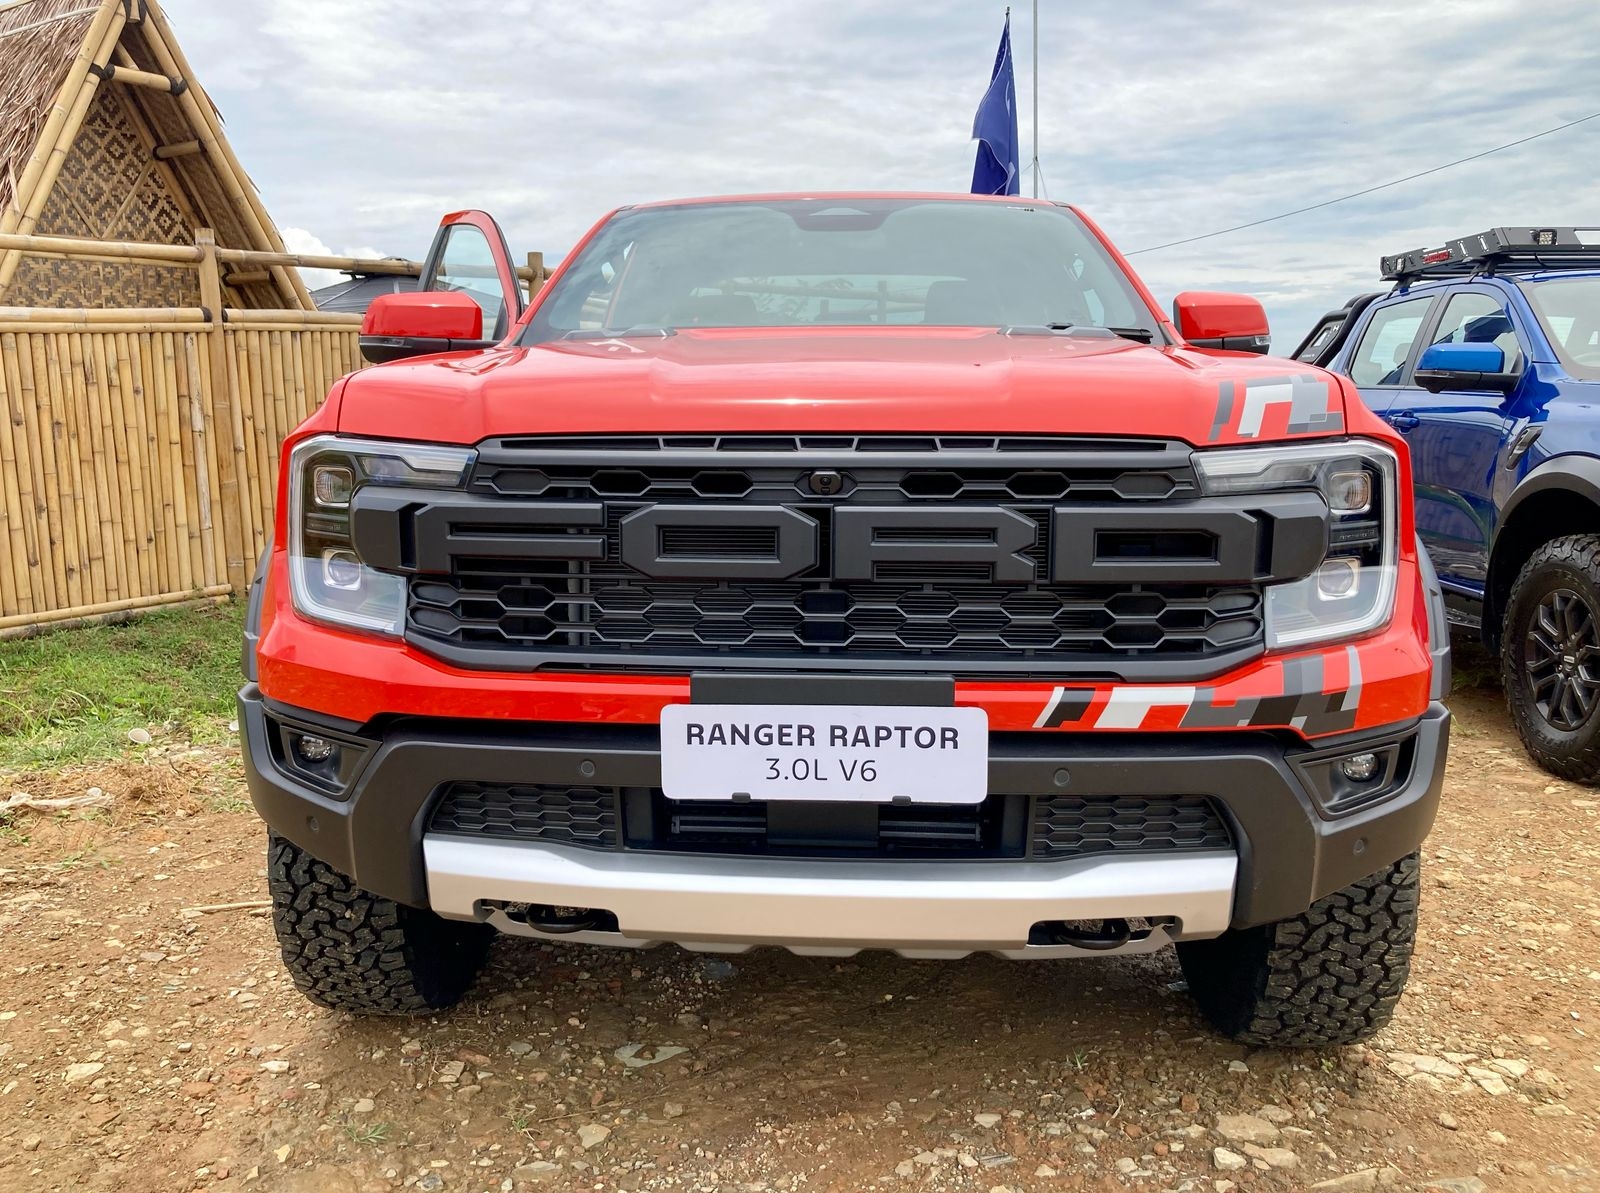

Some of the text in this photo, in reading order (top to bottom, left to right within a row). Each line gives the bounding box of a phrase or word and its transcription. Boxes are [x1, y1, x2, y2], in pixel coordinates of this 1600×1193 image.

[414, 500, 1258, 583] FORD
[686, 723, 959, 750] RANGER RAPTOR
[765, 757, 877, 782] 3.0L V6
